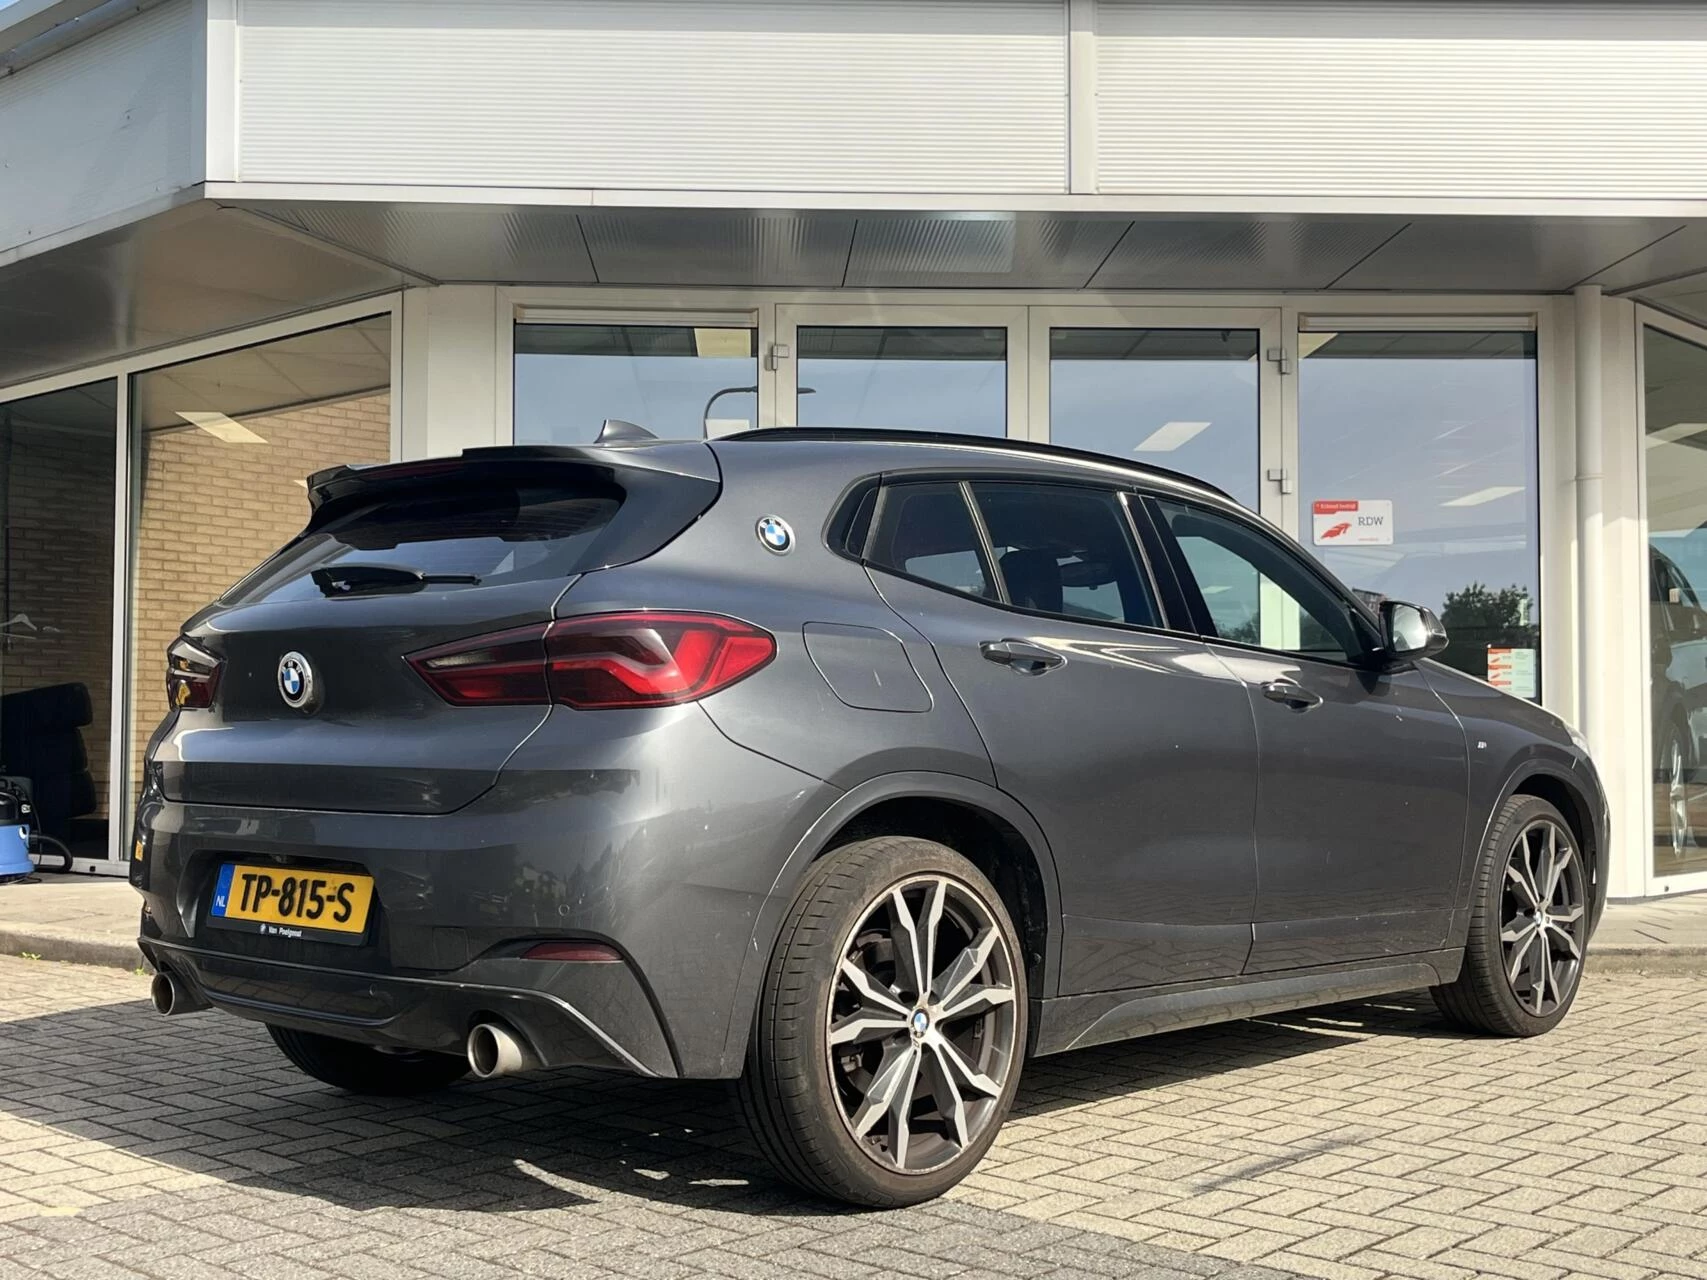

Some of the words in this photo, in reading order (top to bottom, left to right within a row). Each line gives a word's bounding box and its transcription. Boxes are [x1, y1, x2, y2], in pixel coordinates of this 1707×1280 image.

[1358, 516, 1384, 526] RDW
[215, 895, 226, 908] NL
[240, 873, 355, 923] TP-815-S
